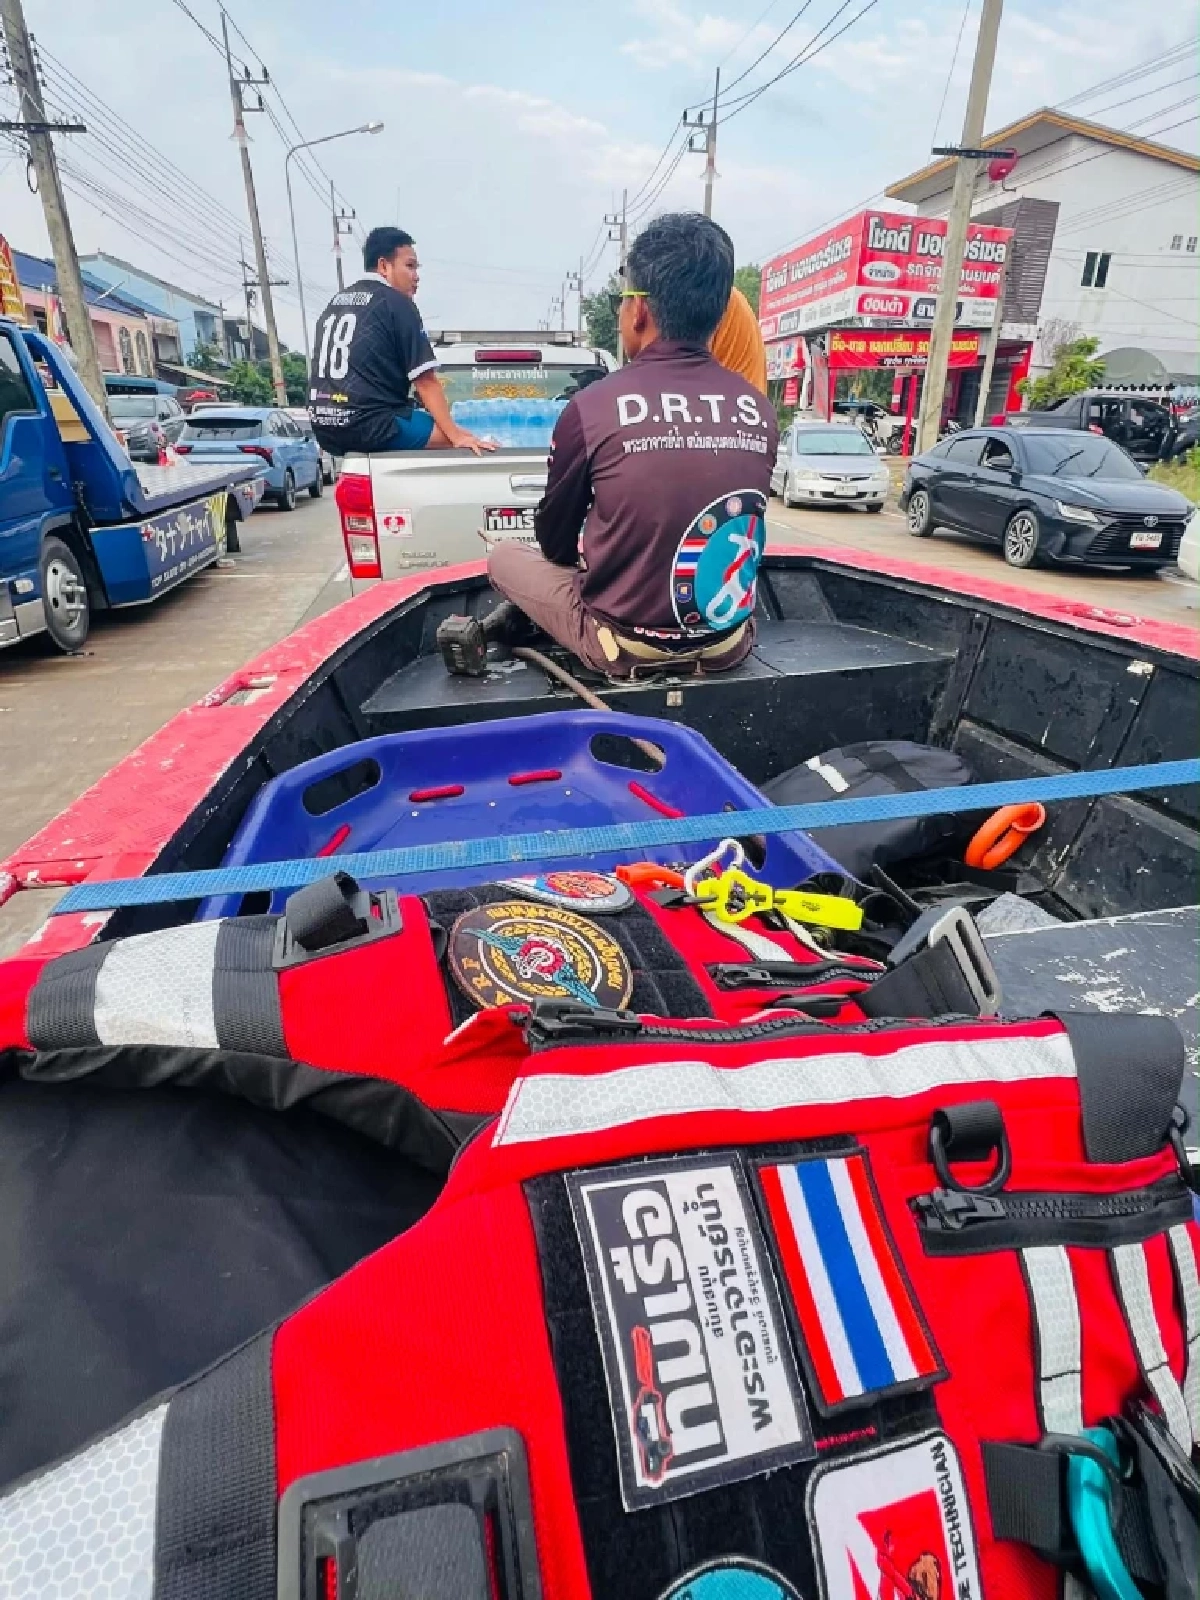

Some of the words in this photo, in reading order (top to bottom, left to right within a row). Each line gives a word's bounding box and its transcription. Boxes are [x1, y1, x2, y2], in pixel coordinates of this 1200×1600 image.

[867, 217, 912, 252] โชคดี
[318, 313, 357, 379] 18
[616, 393, 768, 429] D.R.T.S.
[683, 1182, 774, 1432] พระอาจารย์น้ำ
[698, 1266, 724, 1338] สนับสนุน
[930, 1441, 967, 1575] TECHNICIAN
